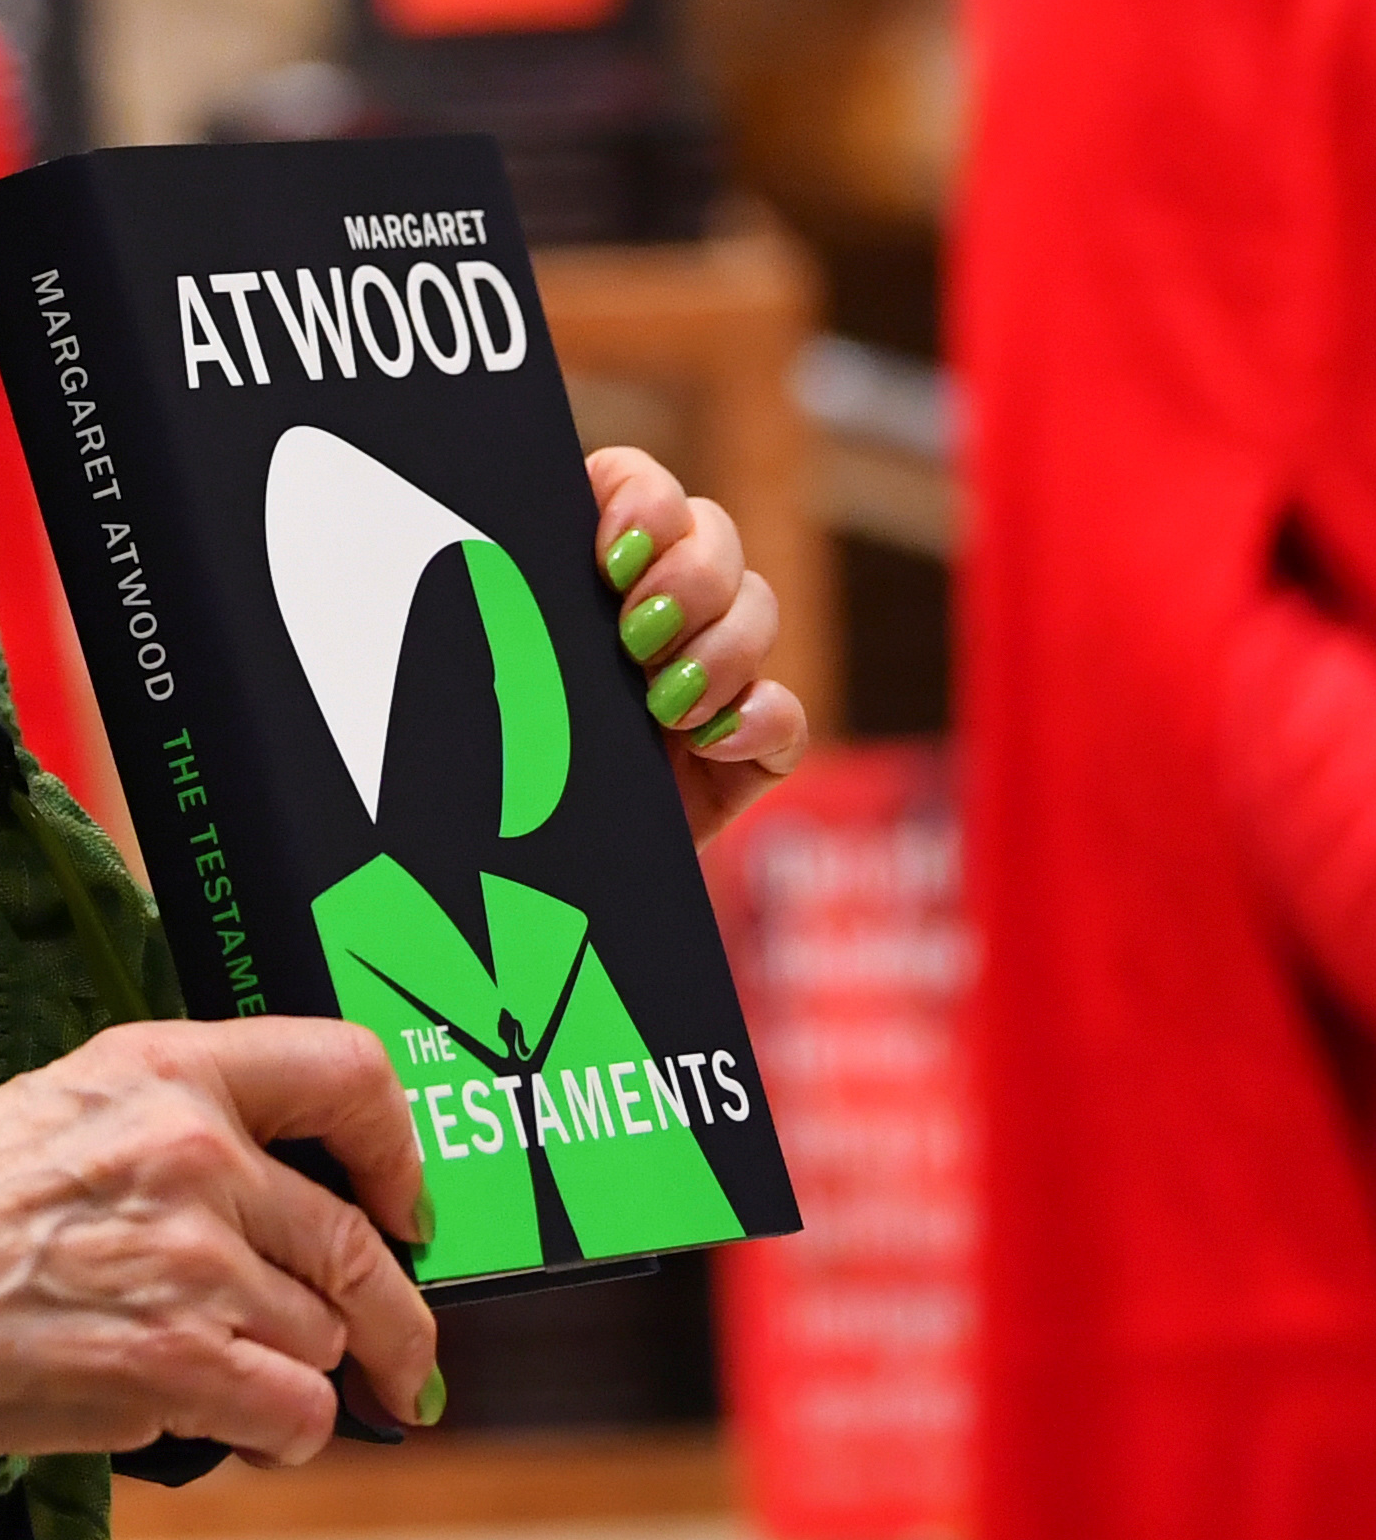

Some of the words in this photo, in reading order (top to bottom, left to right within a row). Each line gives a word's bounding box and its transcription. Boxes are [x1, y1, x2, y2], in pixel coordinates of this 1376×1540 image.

[343, 209, 487, 251] MARGARET
[176, 260, 527, 389] ATWOOD
[31, 268, 122, 502] MARGARET
[101, 522, 175, 702] ATWOOD
[163, 727, 208, 813] THE
[190, 822, 267, 1018] TESTAME
[400, 1024, 457, 1064] THE
